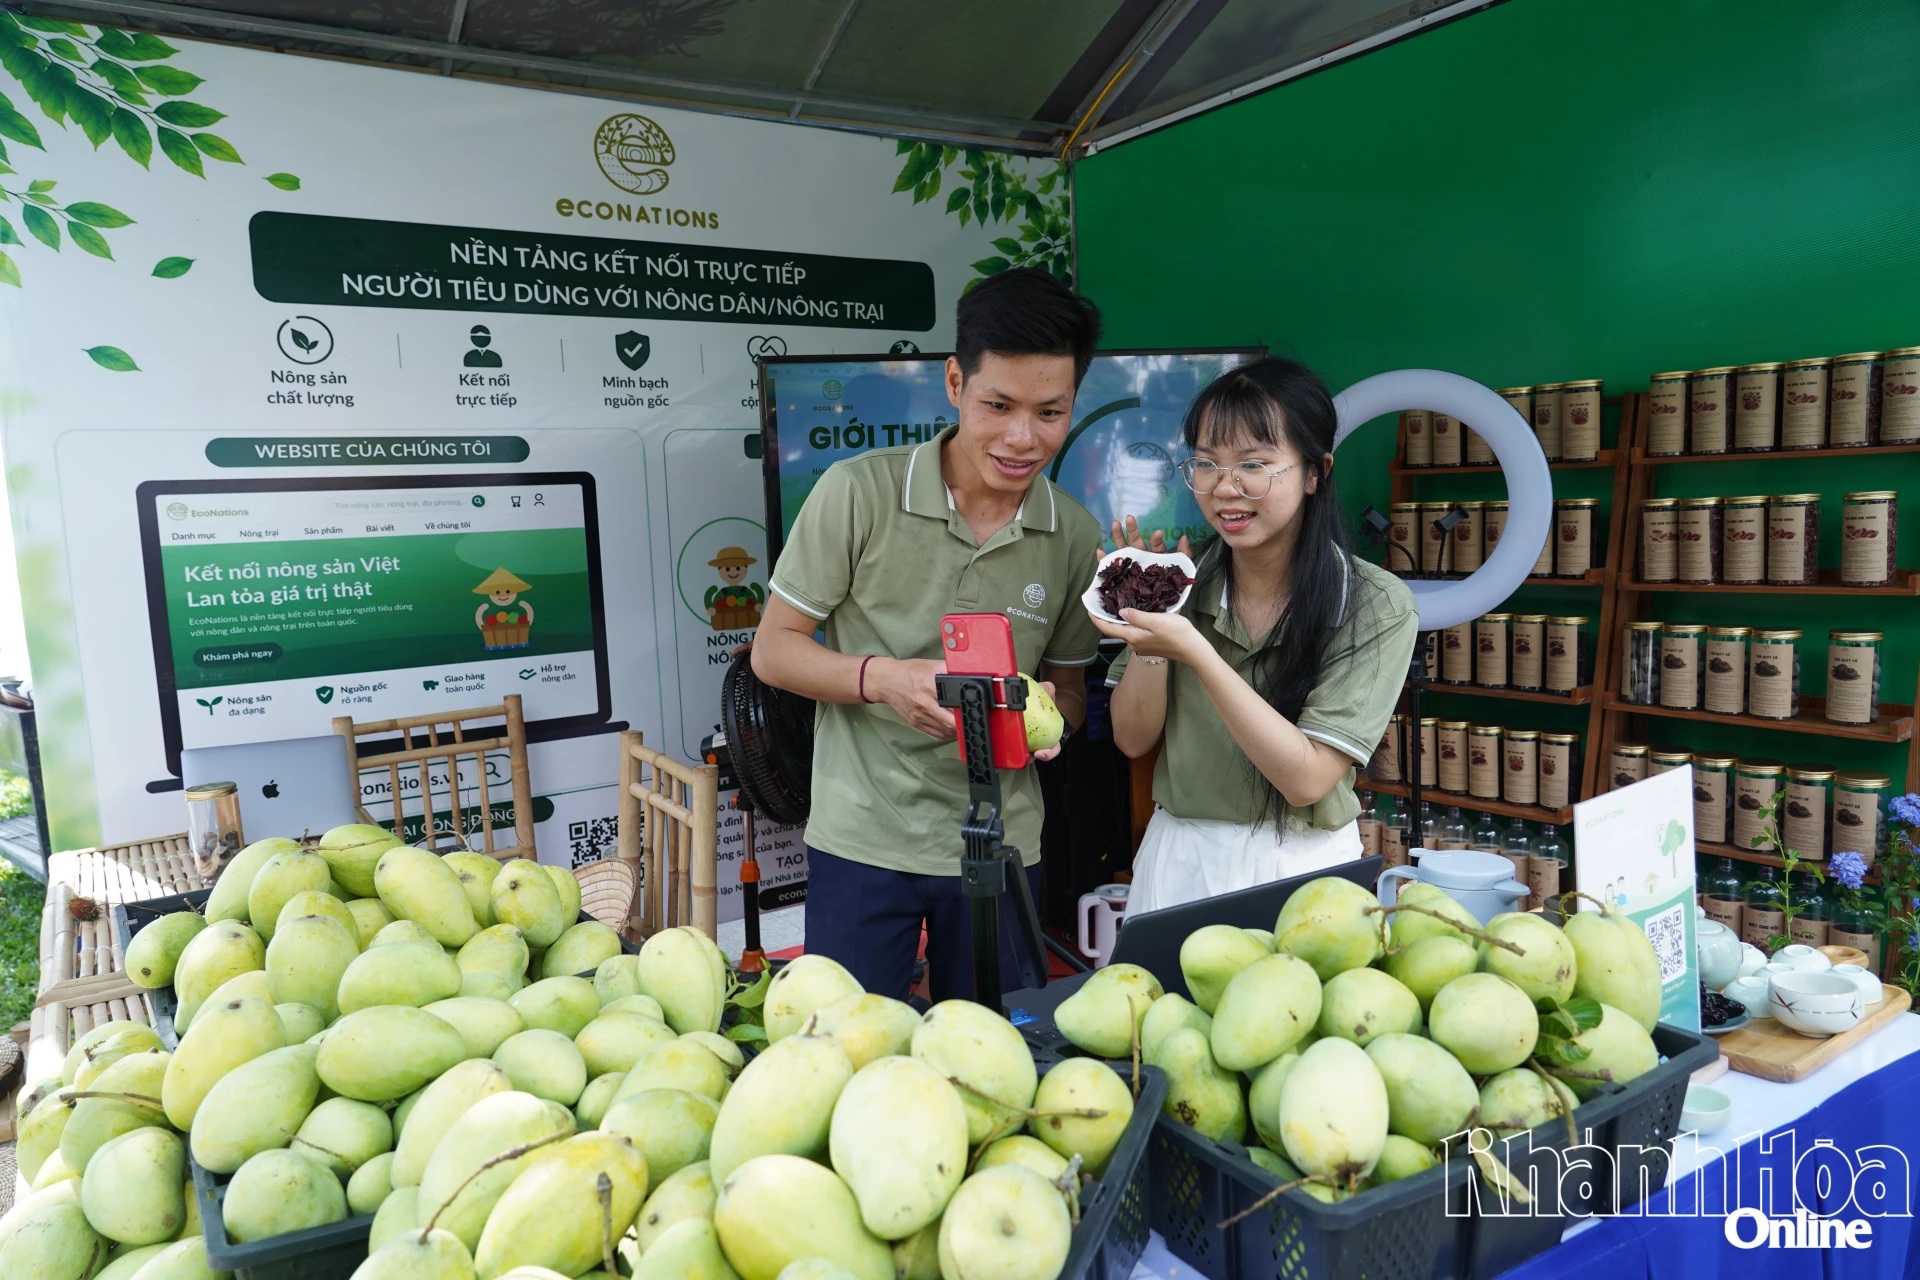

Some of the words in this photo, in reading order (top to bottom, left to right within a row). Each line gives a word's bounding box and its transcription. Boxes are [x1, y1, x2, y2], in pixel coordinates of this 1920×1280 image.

[450, 237, 507, 267] NỀN
[514, 243, 587, 273] TẢNG
[594, 248, 638, 276] KẾT
[645, 252, 689, 279] NỐI
[695, 259, 758, 287] TRỰC
[762, 260, 807, 286] TIẾP
[341, 272, 441, 299] NGƯỜI
[448, 277, 507, 302] TIÊU
[515, 279, 590, 307] DÙNG
[594, 284, 638, 309] VỚI
[645, 287, 714, 314] NÔNG
[720, 291, 838, 319] DÂN/NÔNG
[842, 301, 885, 325] TRẠI
[270, 369, 316, 386] Nông
[320, 369, 347, 385] sản
[459, 373, 485, 387] Kết
[488, 373, 511, 387] nối
[602, 376, 636, 389] Minh
[639, 377, 669, 391] bạch
[267, 390, 303, 405] chất
[307, 391, 355, 408] lượng
[456, 393, 487, 407] trực
[490, 393, 518, 408] tiếp
[604, 392, 644, 409] nguồn
[647, 393, 670, 409] gốc
[808, 416, 875, 450] GIỚI
[254, 443, 342, 459] WEBSITE
[346, 440, 387, 458] CỦA
[391, 439, 458, 457] CHÚNG
[461, 439, 491, 457] TÔI
[191, 508, 249, 518] EcoNations
[304, 526, 320, 535] Sản
[321, 525, 343, 537] phẩm
[366, 524, 378, 533] Bài
[379, 523, 395, 532] viết
[425, 522, 436, 531] Về
[437, 521, 459, 531] chúng
[461, 520, 471, 529] tôi
[172, 532, 196, 541] Danh
[197, 532, 216, 541] mục
[239, 529, 260, 539] Nông
[262, 528, 279, 538] trại
[184, 563, 223, 583] Kết
[228, 561, 261, 581] nối
[267, 561, 318, 580] nông
[322, 559, 356, 575] sản
[360, 555, 400, 575] Việt
[187, 590, 226, 608] Lan
[231, 588, 265, 604] tỏa
[271, 582, 300, 606] giá
[305, 583, 328, 602] trị
[333, 581, 373, 600] thật
[189, 616, 238, 626] EcoNations
[240, 615, 248, 624] là
[250, 613, 266, 622] nền
[268, 611, 286, 622] tảng
[287, 609, 301, 619] kết
[303, 609, 316, 618] nối
[318, 608, 334, 618] trực
[336, 606, 352, 617] tiếp
[353, 605, 376, 616] người
[378, 604, 393, 613] tiêu
[394, 602, 413, 613] dùng
[190, 627, 204, 637] với
[206, 627, 228, 637] nông
[230, 625, 246, 634] dân
[247, 624, 258, 633] và
[260, 623, 281, 633] nông
[283, 621, 297, 631] trại
[299, 620, 315, 629] trên
[317, 618, 336, 628] toàn
[707, 632, 749, 648] NÔNG
[203, 651, 230, 663] Khám
[233, 650, 250, 661] phá
[251, 649, 274, 660] ngay
[540, 663, 552, 673] Hỗ
[554, 663, 567, 672] trợ
[444, 674, 464, 683] Giao
[465, 672, 485, 684] hàng
[541, 674, 559, 684] nông
[560, 673, 576, 682] dân
[340, 683, 371, 695] Nguồn
[371, 681, 388, 693] gốc
[445, 685, 464, 694] toàn
[465, 682, 485, 693] quốc
[227, 694, 253, 706] Nông
[256, 693, 273, 704] sản
[341, 696, 352, 705] rõ
[353, 694, 373, 705] ràng
[228, 707, 241, 717] đa
[241, 705, 266, 716] dạng
[756, 844, 773, 854] của
[776, 853, 804, 869] TẠO
